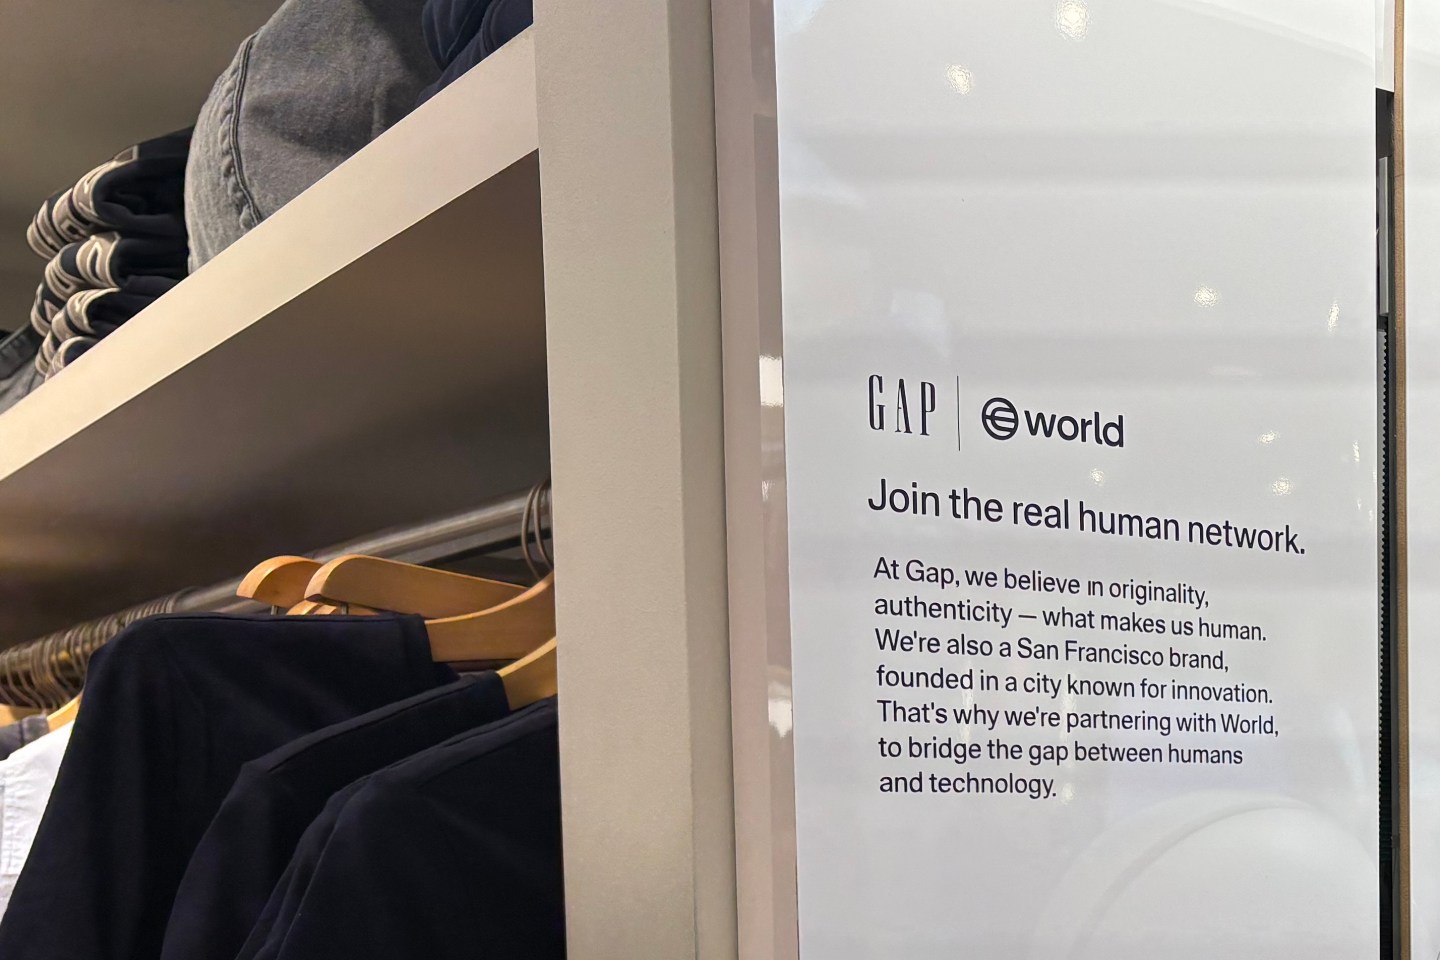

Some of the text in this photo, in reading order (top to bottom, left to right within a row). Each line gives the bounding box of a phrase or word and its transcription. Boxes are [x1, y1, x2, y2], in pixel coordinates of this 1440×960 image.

[868, 374, 1124, 448] GAP world
[867, 478, 1306, 555] Join the real human network.
[873, 556, 1209, 609] At Gap, we believe in originality,
[874, 594, 1013, 628] authenticity
[1041, 605, 1096, 630] what
[1100, 611, 1166, 635] makes
[1171, 619, 1194, 637] us
[1198, 616, 1267, 642] human.
[874, 627, 1229, 673] We're also a San Francisco brand,
[875, 663, 1273, 704] founded in a city known for innovation.
[876, 699, 1279, 738] That's why we're partnering with World,
[877, 735, 1244, 767] to bridge the gap between humans
[879, 770, 1057, 800] and technology.
